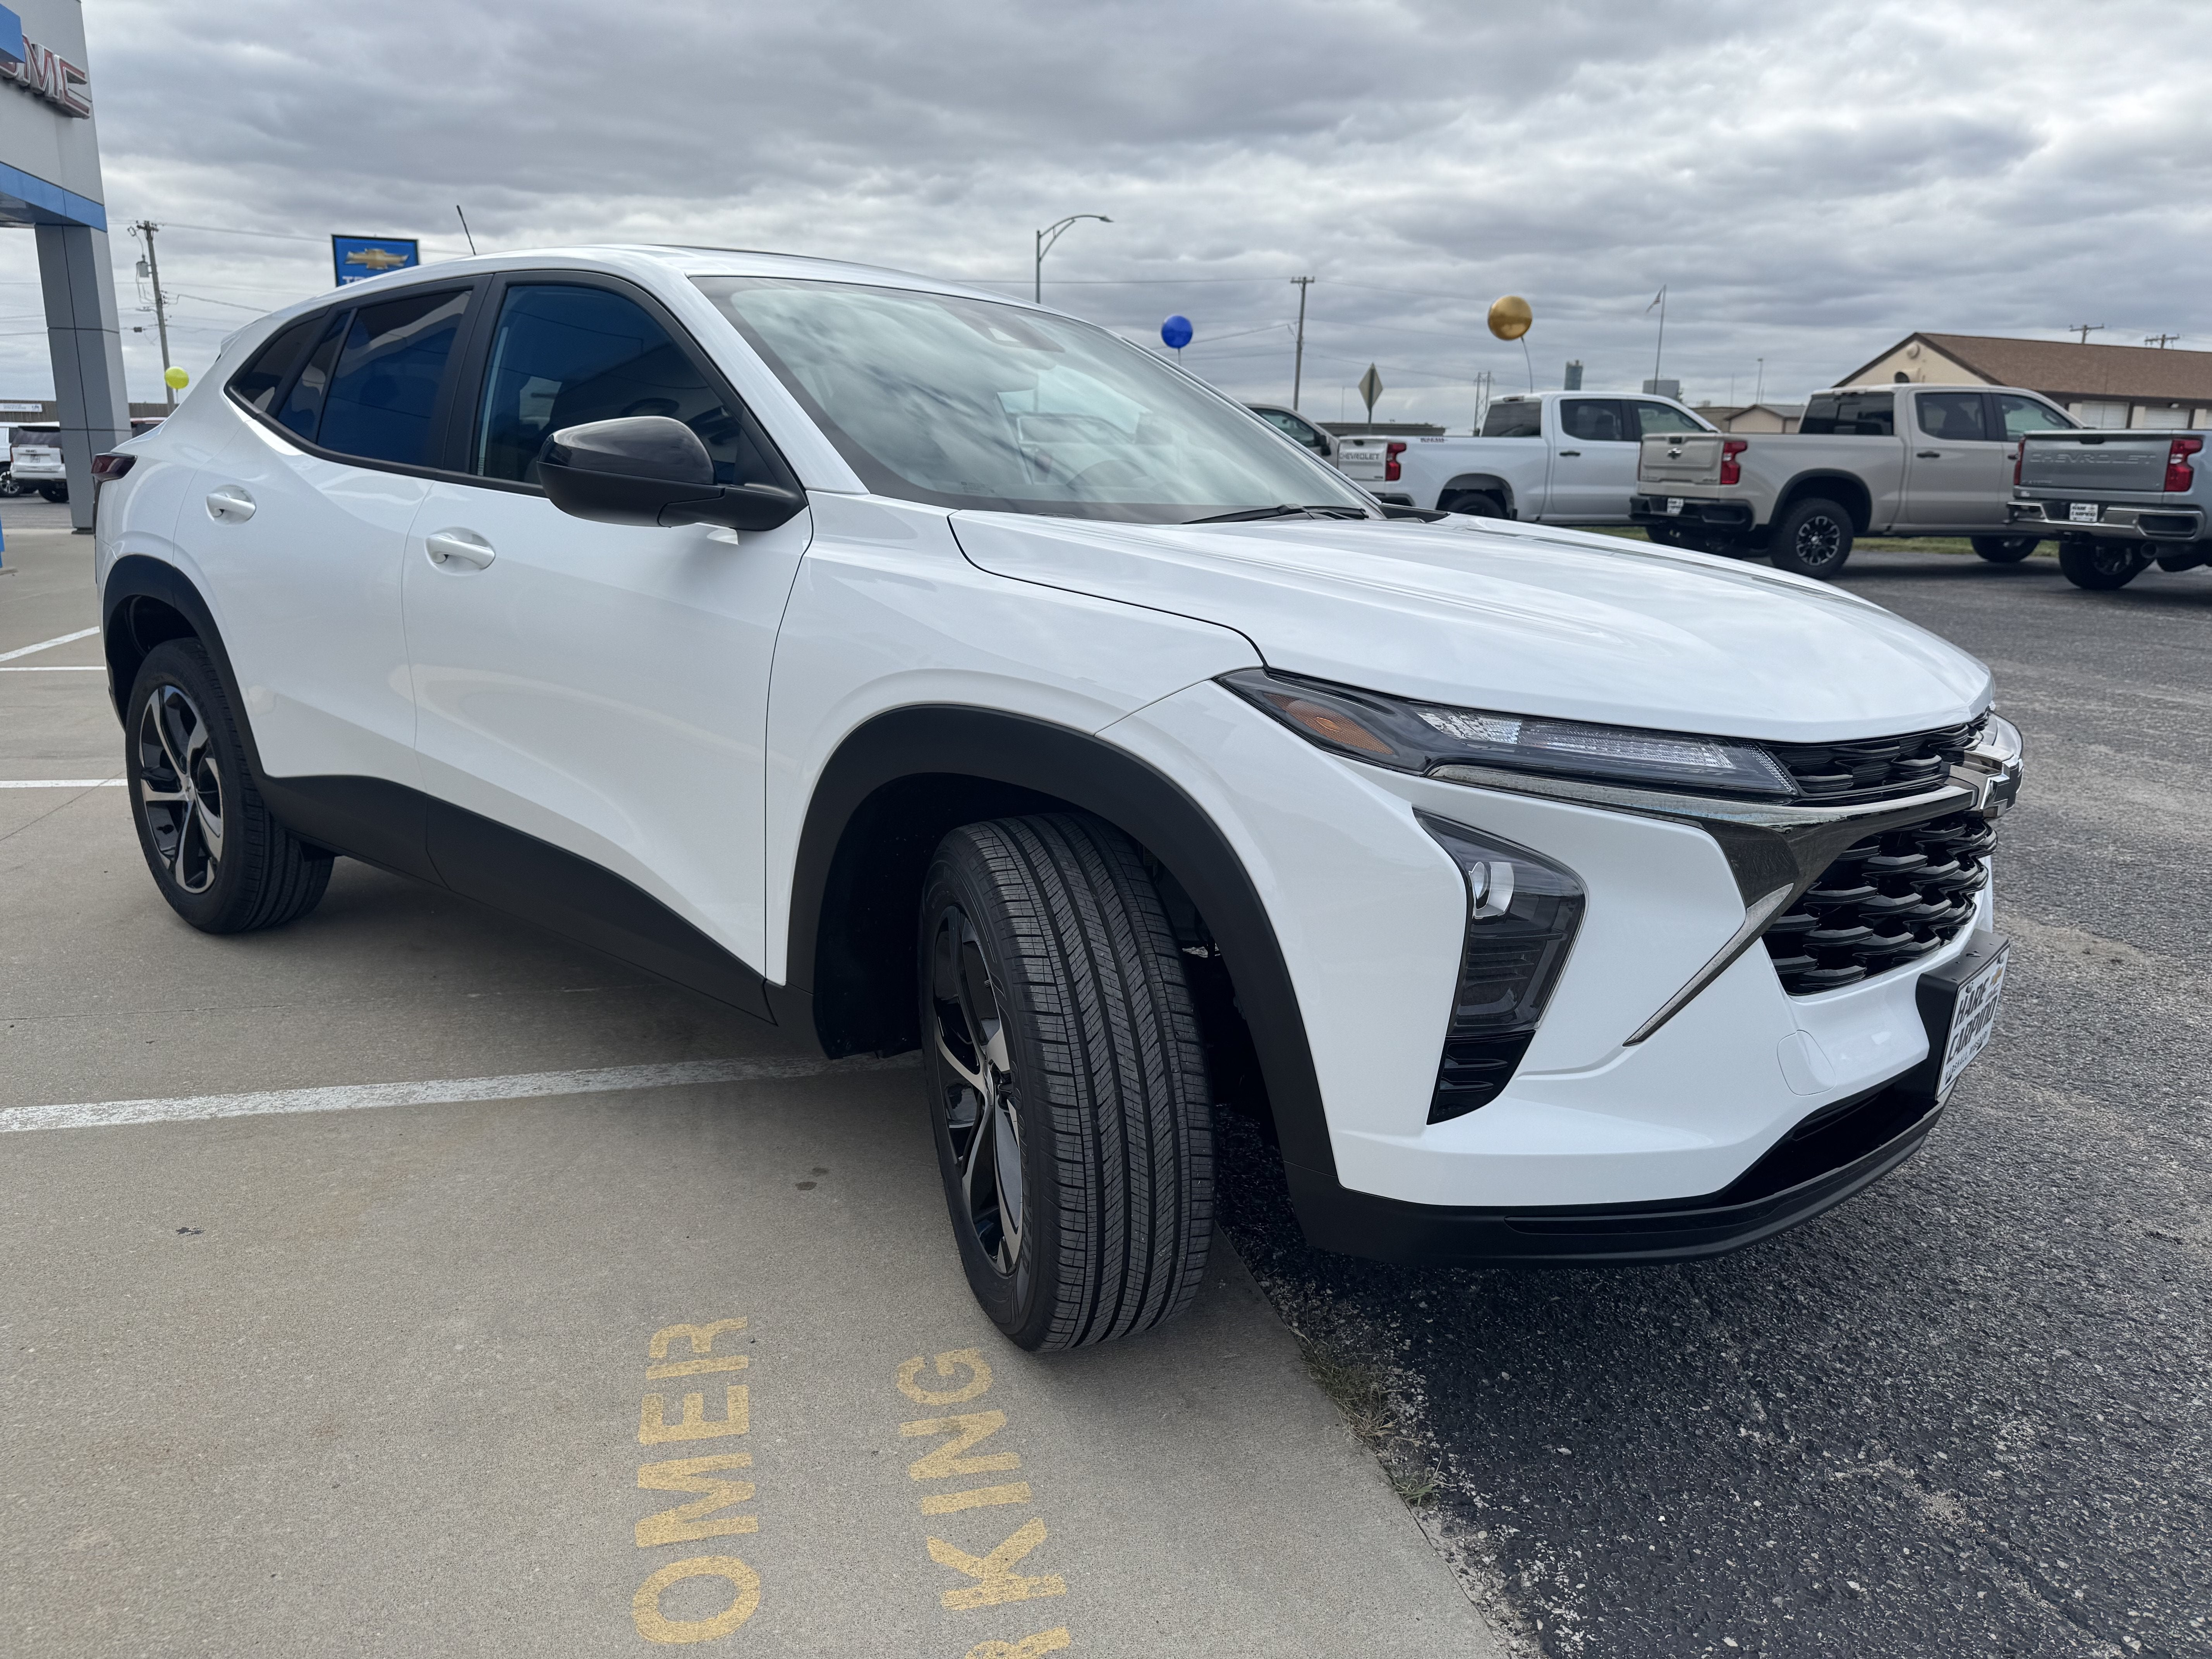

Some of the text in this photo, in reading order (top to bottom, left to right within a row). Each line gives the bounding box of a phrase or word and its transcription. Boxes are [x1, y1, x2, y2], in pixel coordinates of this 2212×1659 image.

[0, 33, 91, 119] MC
[2029, 453, 2157, 464] CHEVROLET
[1946, 994, 1997, 1065] CARPINO
[1954, 976, 1990, 1029] HARE
